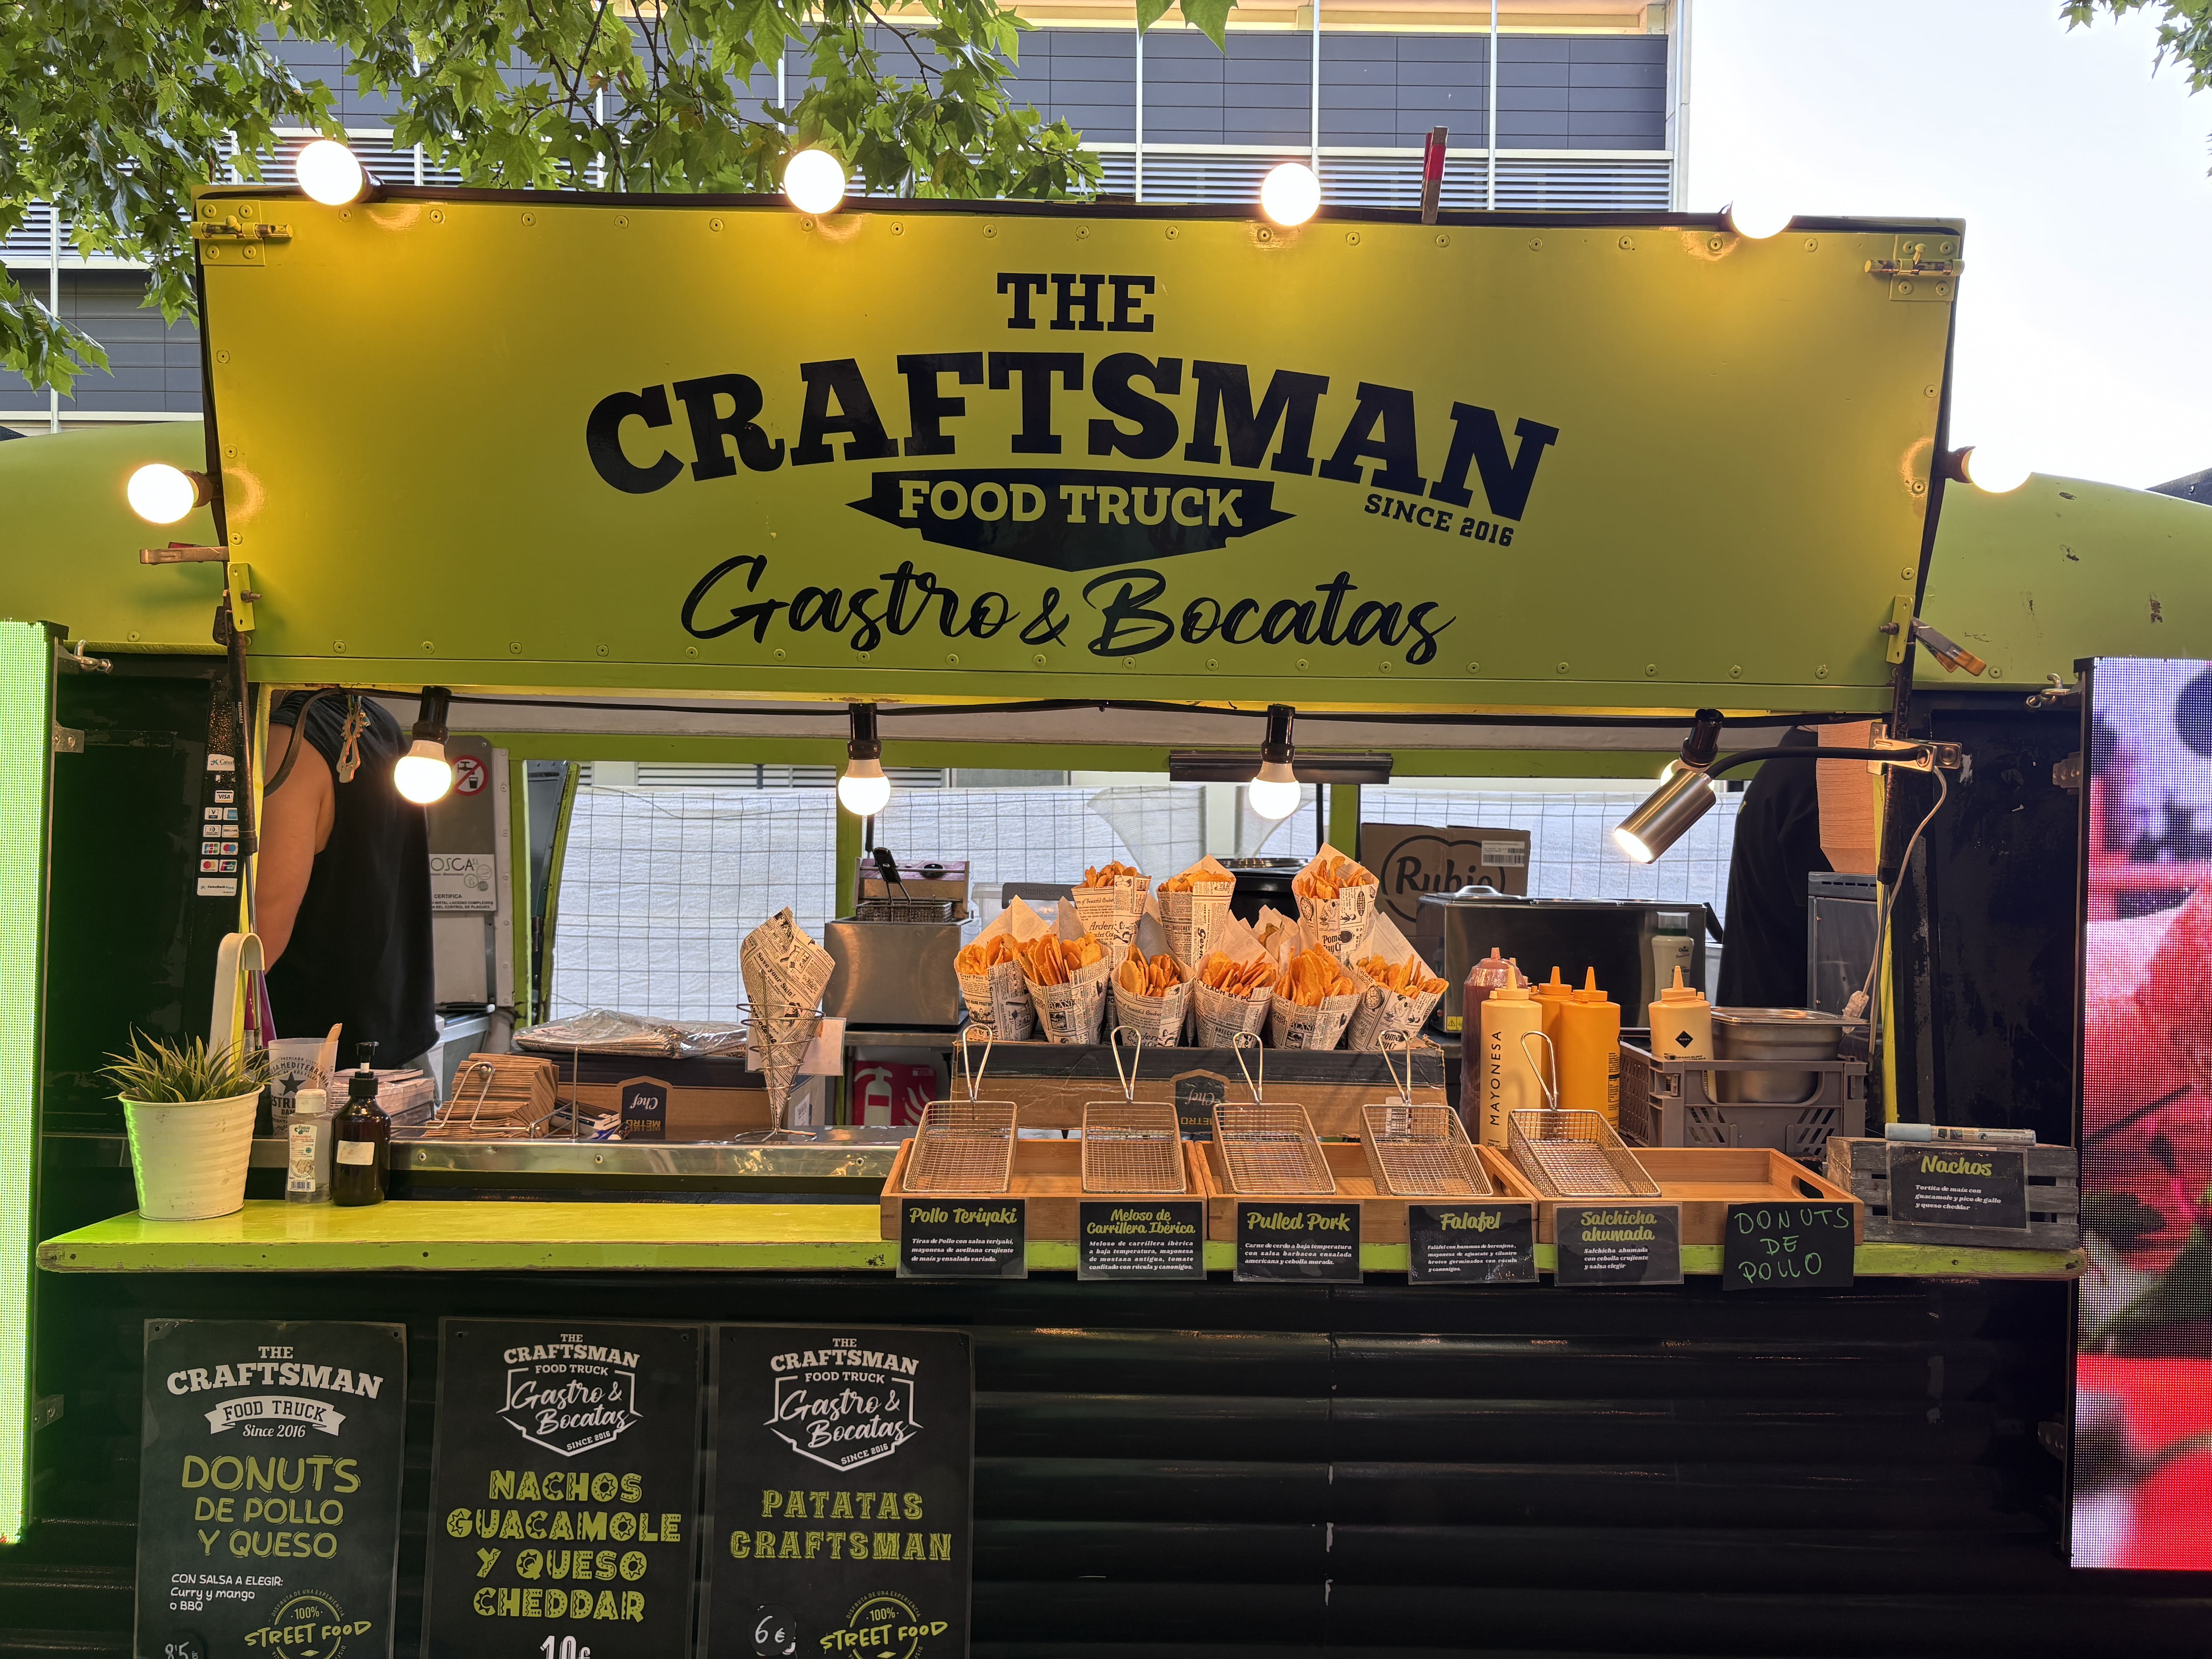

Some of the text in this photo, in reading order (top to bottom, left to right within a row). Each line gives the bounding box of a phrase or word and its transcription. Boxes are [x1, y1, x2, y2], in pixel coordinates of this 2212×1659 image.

[997, 273, 1155, 332] THE
[586, 352, 1559, 522] CRAFTSMAN
[900, 480, 1242, 527] FOOD TRUCK
[1364, 493, 1515, 547] SINCE 2016
[681, 555, 1456, 665] Gastro & Bocatas
[1396, 856, 1492, 894] Rubio
[768, 968, 782, 984] your
[1202, 982, 1225, 995] TEACH
[1490, 1031, 1501, 1125] MAYONESA
[630, 1093, 658, 1109] Chef
[1921, 1156, 1992, 1176] Nachos
[910, 1207, 1017, 1226] Pollo Teriyaki
[1111, 1209, 1171, 1221] Meloso de
[1247, 1212, 1350, 1231] Pulled Pork
[1440, 1212, 1501, 1232] Falafel
[1581, 1210, 1657, 1225] Salchicha
[1734, 1208, 1848, 1234] DONUTS
[1087, 1222, 1147, 1234] Carrillera
[1582, 1226, 1655, 1241] ahumada
[1760, 1235, 1799, 1255] DE
[1738, 1253, 1821, 1283] POLLO
[560, 1334, 583, 1342] THE
[832, 1338, 857, 1347] THE
[258, 1346, 293, 1358] THE
[504, 1344, 640, 1368] CRAFTSMAN
[771, 1350, 919, 1375] CRAFTSMAN
[167, 1362, 383, 1398] CRAFTSMAN
[535, 1364, 608, 1376] FOOD TRUCK
[805, 1372, 884, 1383] FOOD TRUCK
[512, 1379, 622, 1410] Gastro &
[780, 1388, 900, 1422] Gastro &
[223, 1401, 327, 1421] FOOD TRUCK
[536, 1405, 629, 1434] Bocatas
[243, 1424, 306, 1437] Since 2016
[567, 1431, 611, 1450] SINCE 2016
[807, 1415, 908, 1448] Bocatas
[841, 1443, 888, 1465] SINCE 2016
[182, 1455, 362, 1493] DONUTS
[489, 1470, 642, 1503] NACHOS
[195, 1497, 343, 1525] DE POLLO
[761, 1489, 923, 1520] PATATAS
[447, 1508, 681, 1542] GUACAMOLE
[198, 1530, 337, 1558] Y QUESO
[730, 1530, 951, 1561] CRAFTSMAN
[477, 1548, 647, 1580] Y QUESO
[172, 1574, 283, 1586] CON SALSA A ELEGIR:
[170, 1601, 203, 1611] o BBQ
[171, 1587, 255, 1601] Curry y mango
[474, 1587, 644, 1622] CHEDDAR
[846, 1596, 868, 1619] DISFRUTA
[891, 1591, 921, 1617] EXPERIENCIA
[294, 1606, 319, 1620] 100%
[870, 1607, 895, 1621] 100%
[244, 1621, 371, 1647] STREET FOOD
[820, 1621, 948, 1650] STREET FOOD
